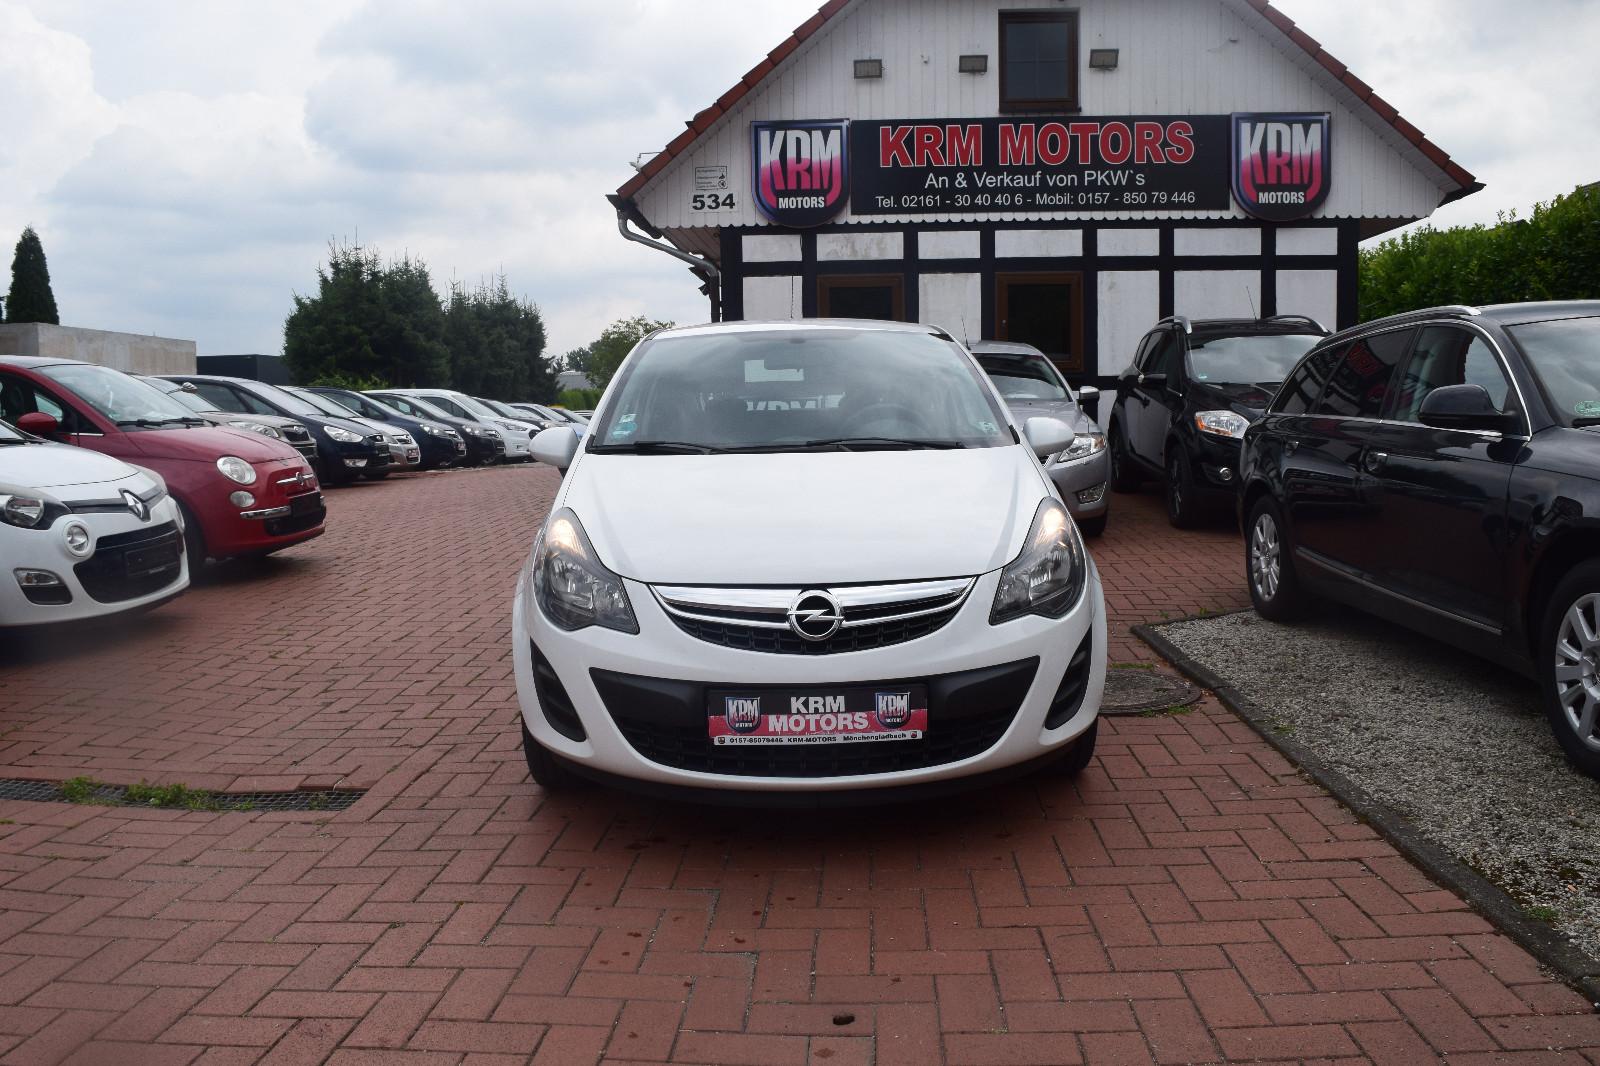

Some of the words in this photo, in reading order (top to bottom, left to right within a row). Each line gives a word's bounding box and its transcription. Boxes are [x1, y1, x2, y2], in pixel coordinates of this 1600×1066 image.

[880, 124, 983, 168] KRM
[998, 120, 1195, 166] MOTORS
[1241, 122, 1322, 185] KRM
[759, 129, 841, 191] KRM
[924, 172, 949, 189] An
[955, 172, 968, 188] &
[973, 170, 1042, 188] Verkauf
[1046, 173, 1078, 187] von
[692, 192, 736, 211] 534
[778, 196, 825, 209] MOTORS
[875, 195, 898, 208] Tel.
[901, 194, 941, 207] 02161
[954, 194, 971, 206] 30
[974, 193, 991, 206] 40
[994, 193, 1011, 205] 40
[1014, 193, 1023, 205] 6
[1035, 192, 1074, 205] Mobil:
[1078, 192, 1110, 205] 0157
[1123, 192, 1148, 204] 850
[1151, 191, 1168, 203] 79
[1170, 191, 1196, 203] 446
[1258, 191, 1305, 204] MOTORS
[728, 698, 758, 721] KRM
[790, 695, 846, 714] KRM
[878, 694, 908, 717] KRM
[768, 711, 869, 732] MOTORS
[787, 735, 837, 743] KRM-MOTORS
[843, 732, 907, 742] Mönchengladbach
